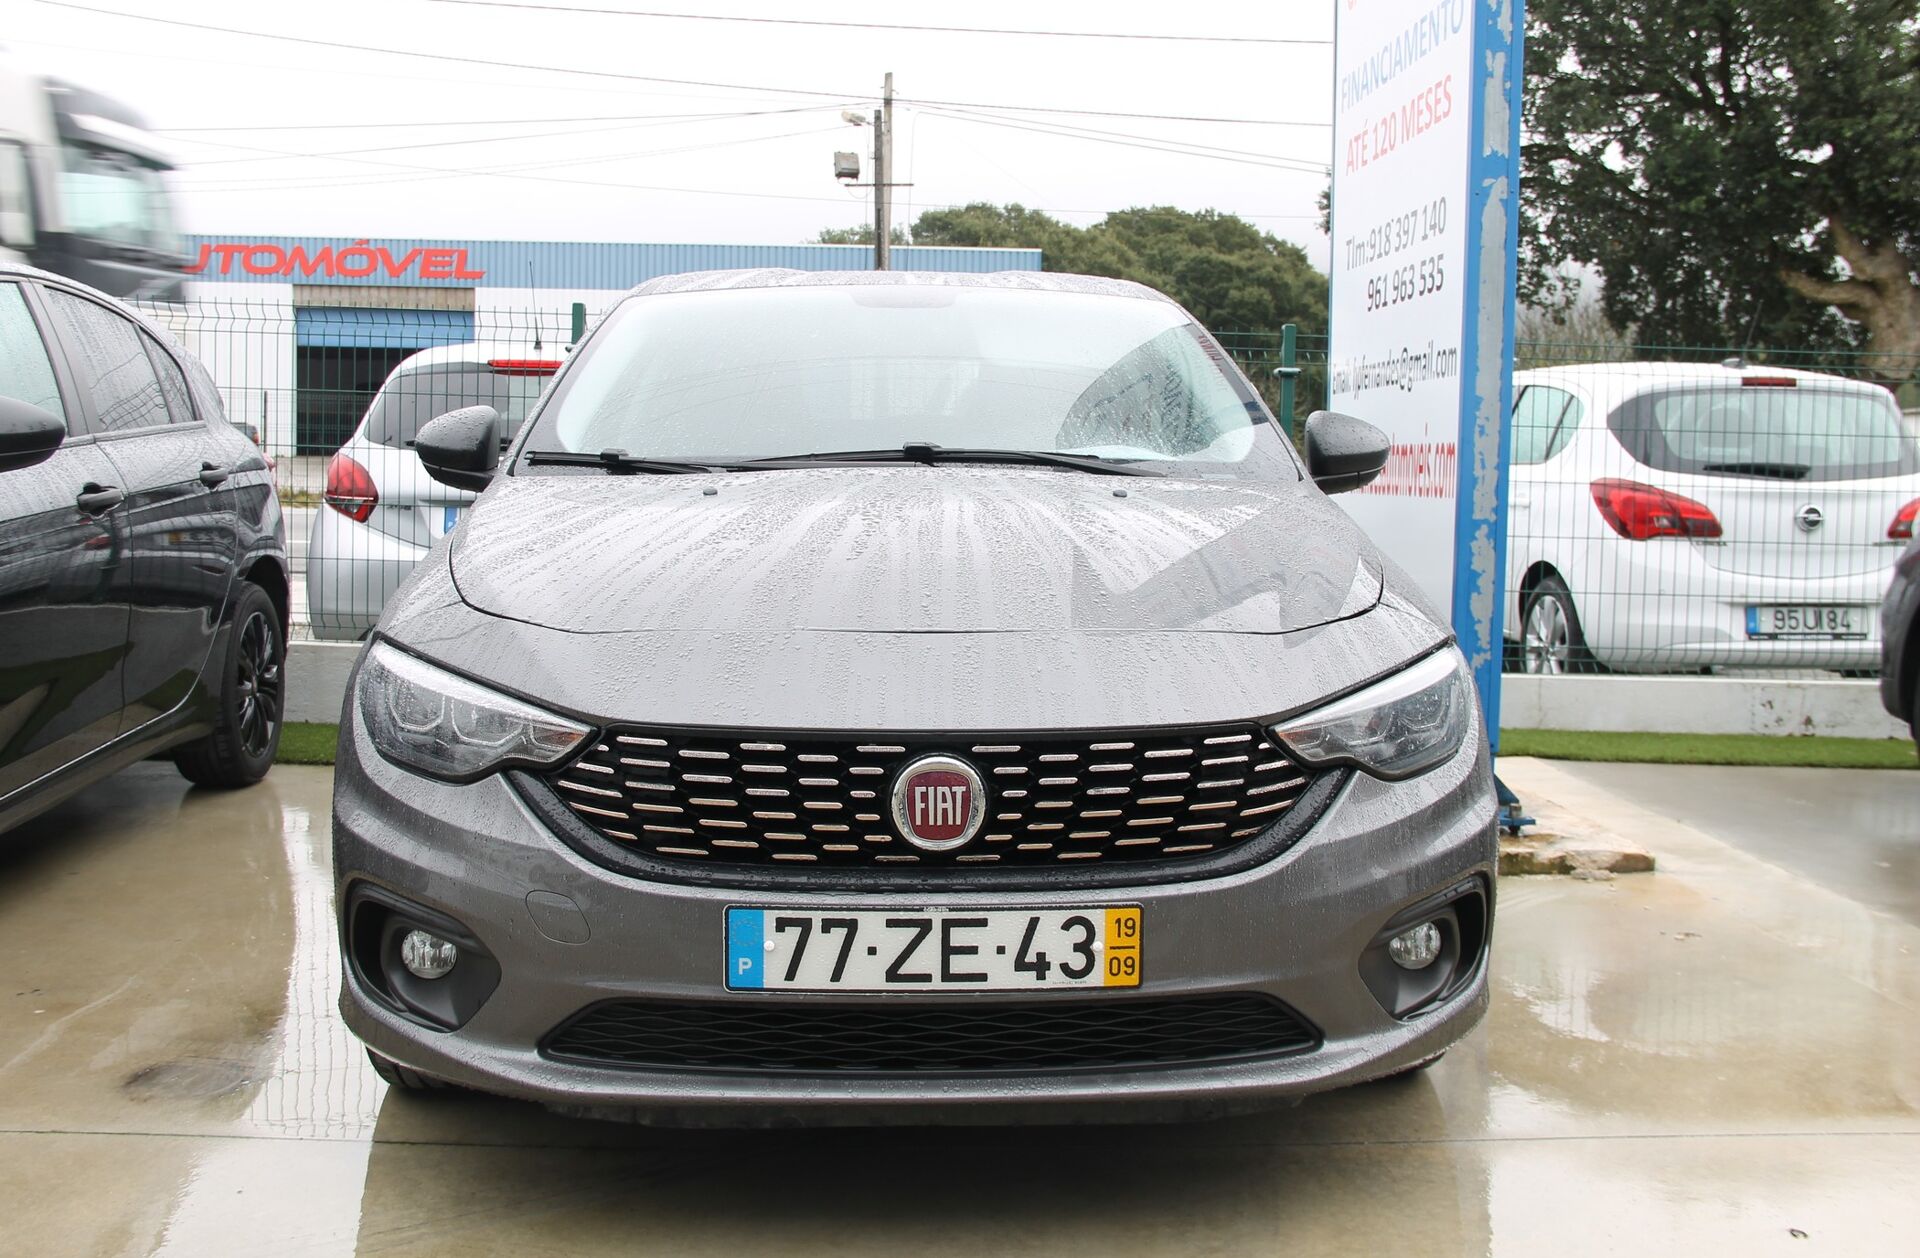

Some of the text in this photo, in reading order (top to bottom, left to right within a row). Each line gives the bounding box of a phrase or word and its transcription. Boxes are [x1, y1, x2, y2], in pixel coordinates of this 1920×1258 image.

[1341, 0, 1464, 114] FINANCIAMENTO
[1345, 74, 1452, 176] ATÉ 120 MESES
[1394, 209, 1418, 252] 397
[1421, 196, 1447, 241] 140
[1367, 253, 1444, 312] 961 963 535
[914, 785, 967, 826] FIAT
[738, 957, 753, 975] P
[1114, 917, 1136, 938] 19
[1108, 956, 1136, 977] 09
